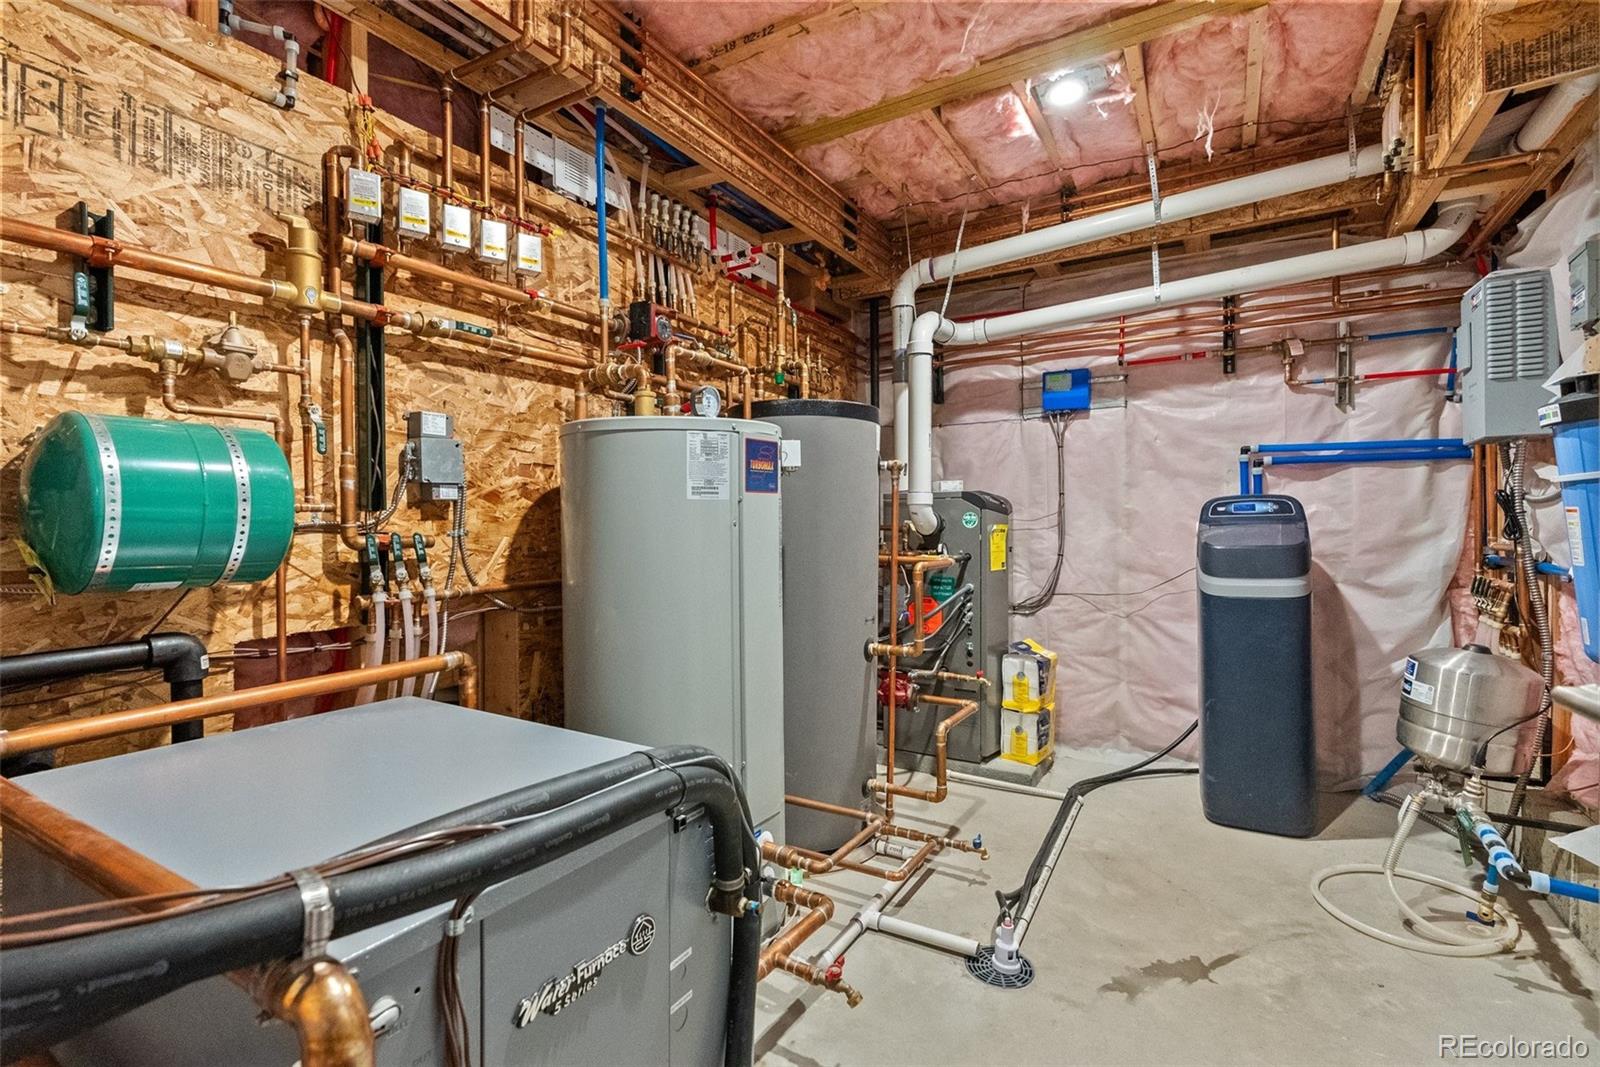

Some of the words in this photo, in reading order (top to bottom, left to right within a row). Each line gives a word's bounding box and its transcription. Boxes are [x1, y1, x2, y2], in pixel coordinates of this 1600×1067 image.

[743, 24, 775, 44] 02:12
[262, 171, 273, 191] 510
[553, 1000, 562, 1015] 5
[563, 977, 599, 1008] Series
